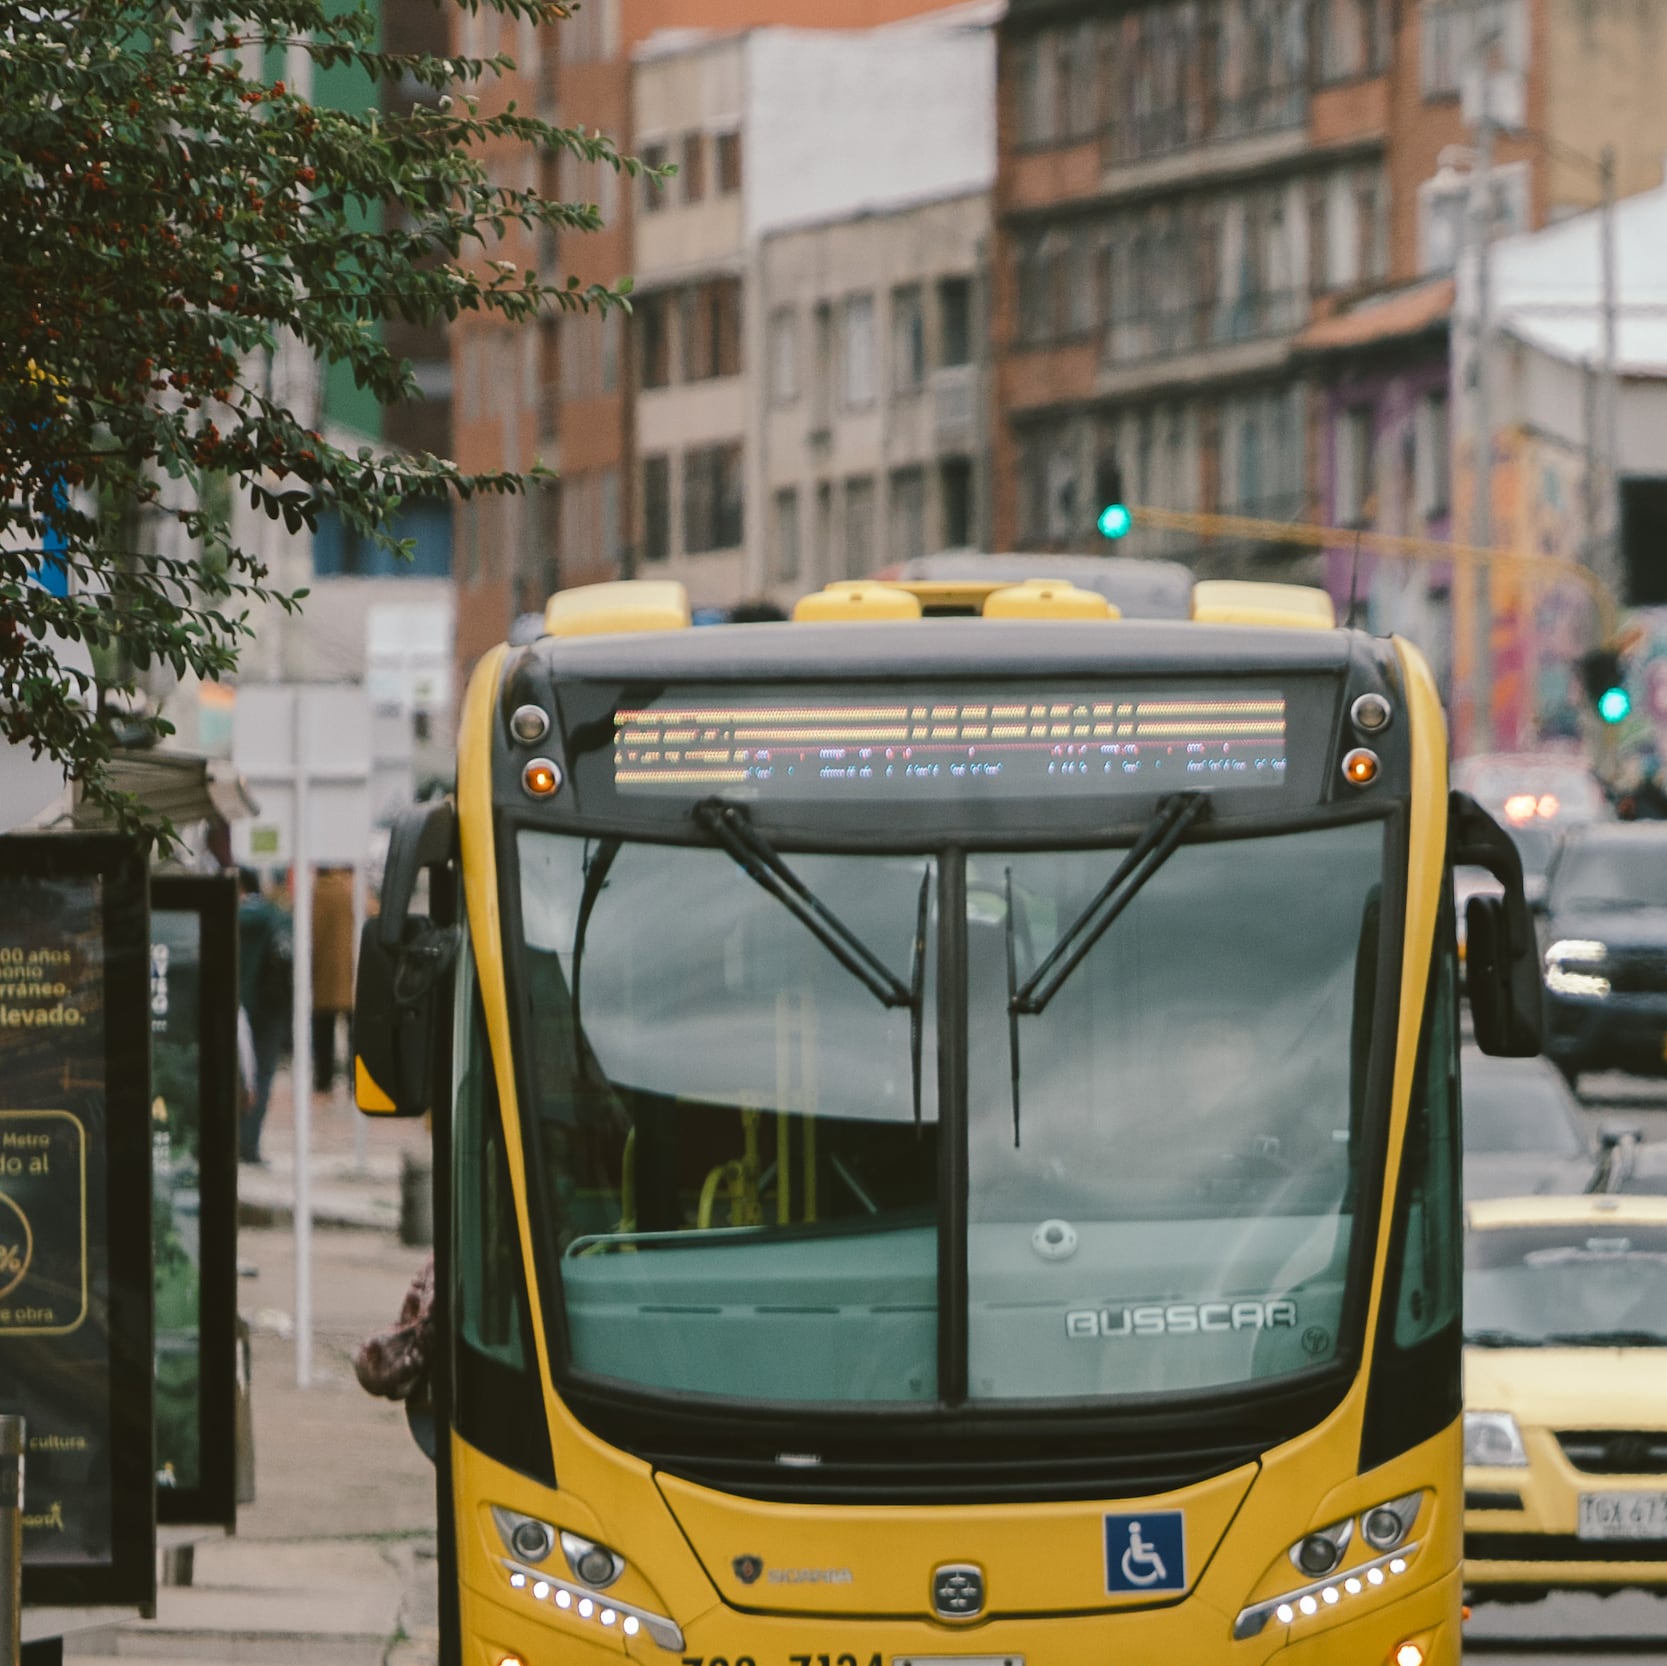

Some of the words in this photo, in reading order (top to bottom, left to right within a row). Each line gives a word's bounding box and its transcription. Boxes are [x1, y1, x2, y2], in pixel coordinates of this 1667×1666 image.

[28, 946, 71, 966] años
[0, 965, 43, 980] onio
[4, 1132, 50, 1147] Metro
[29, 1152, 49, 1175] al
[15, 1306, 54, 1322] obra
[1066, 1300, 1297, 1339] BUSSCAR
